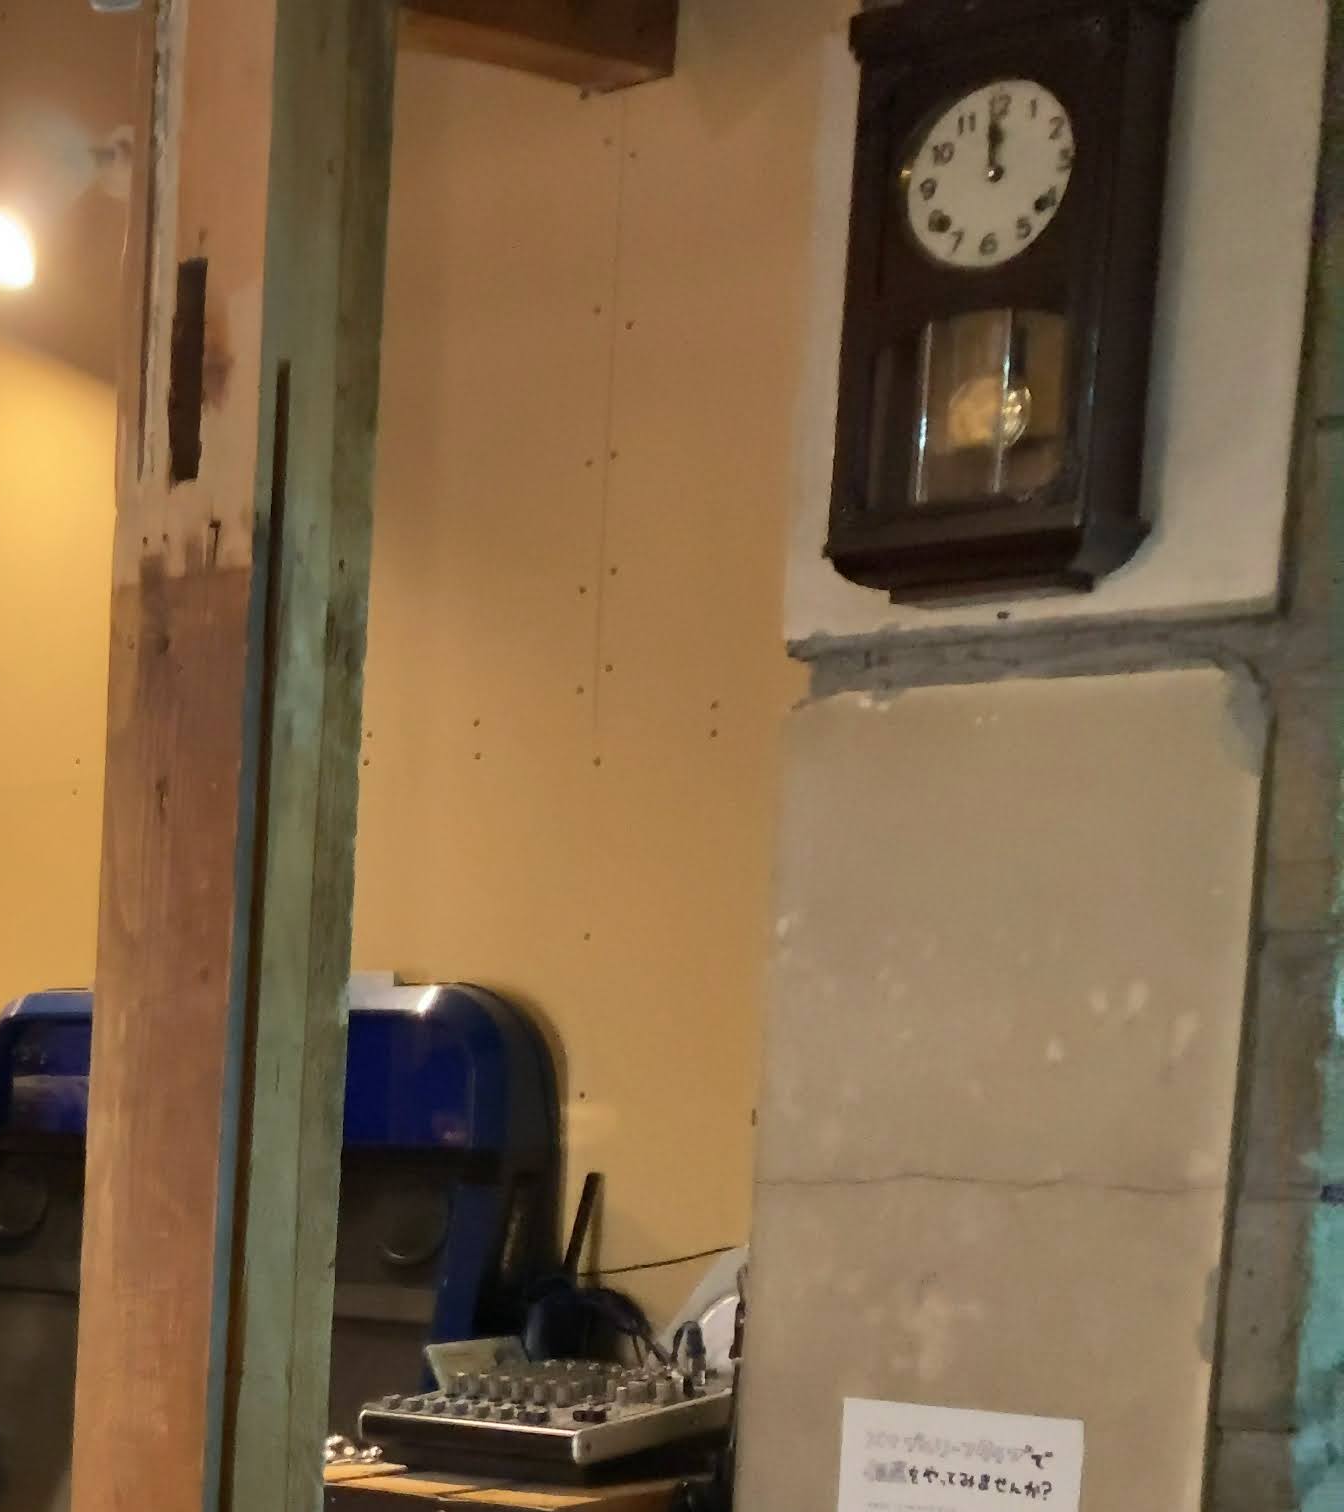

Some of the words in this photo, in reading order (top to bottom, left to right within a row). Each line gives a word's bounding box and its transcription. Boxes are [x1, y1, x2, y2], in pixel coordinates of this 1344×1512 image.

[957, 112, 977, 136] 11
[1048, 116, 1065, 141] 2
[920, 178, 936, 199] 9
[1016, 216, 1031, 239] 5
[950, 231, 964, 256] 7
[980, 232, 998, 256] 6
